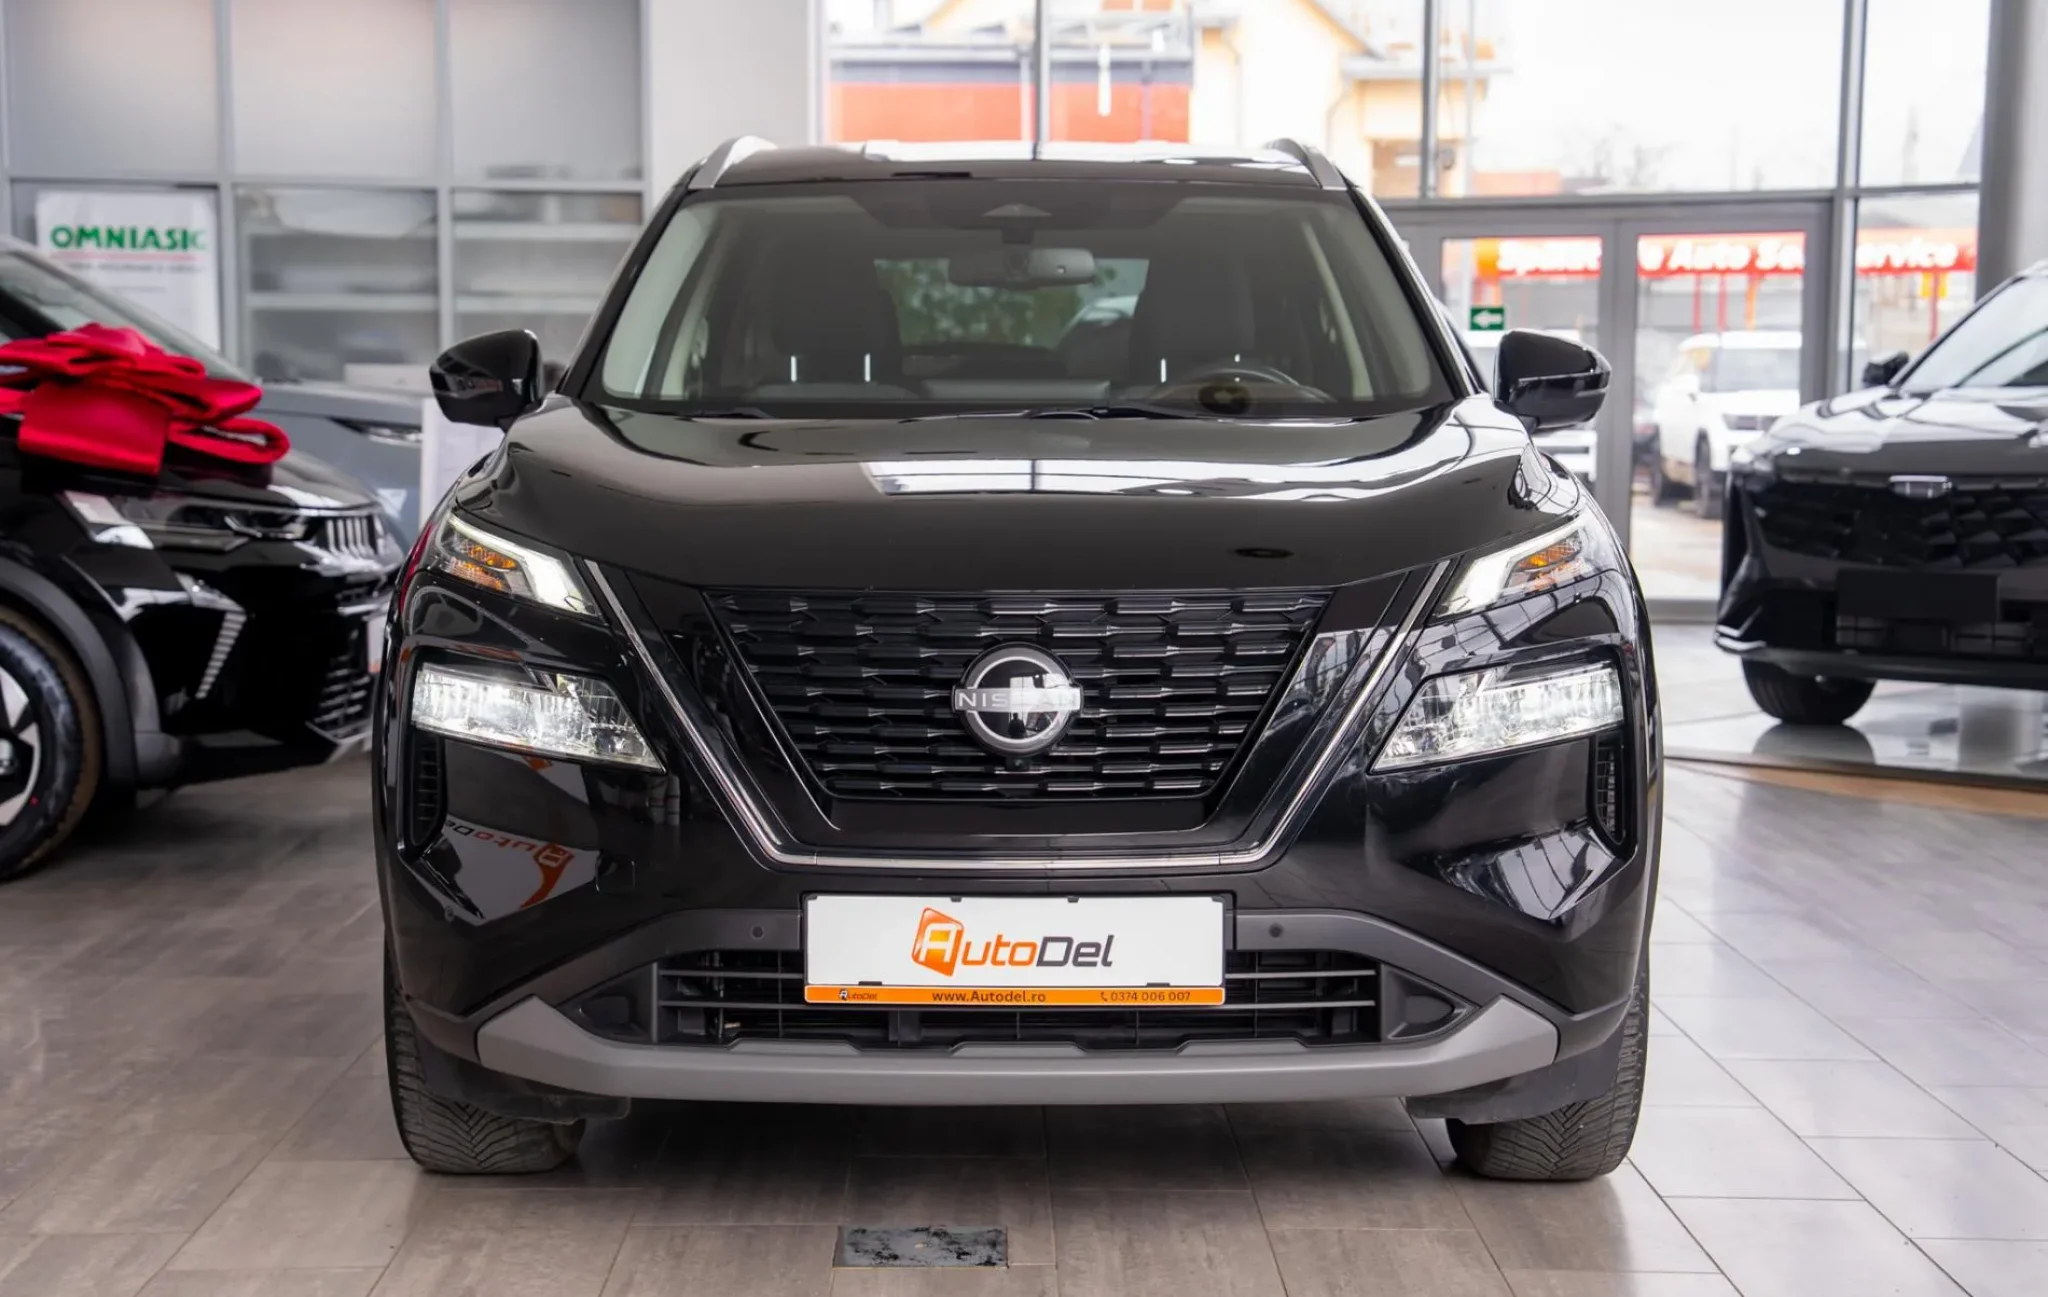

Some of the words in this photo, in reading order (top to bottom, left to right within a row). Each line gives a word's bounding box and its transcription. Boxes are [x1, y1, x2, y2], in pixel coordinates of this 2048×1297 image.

[912, 908, 1114, 976] AutoDel
[932, 990, 1046, 1003] www.Autodel.ro
[1110, 991, 1138, 1002] 0374
[1141, 991, 1165, 1002] 006
[1168, 991, 1191, 1002] 007
